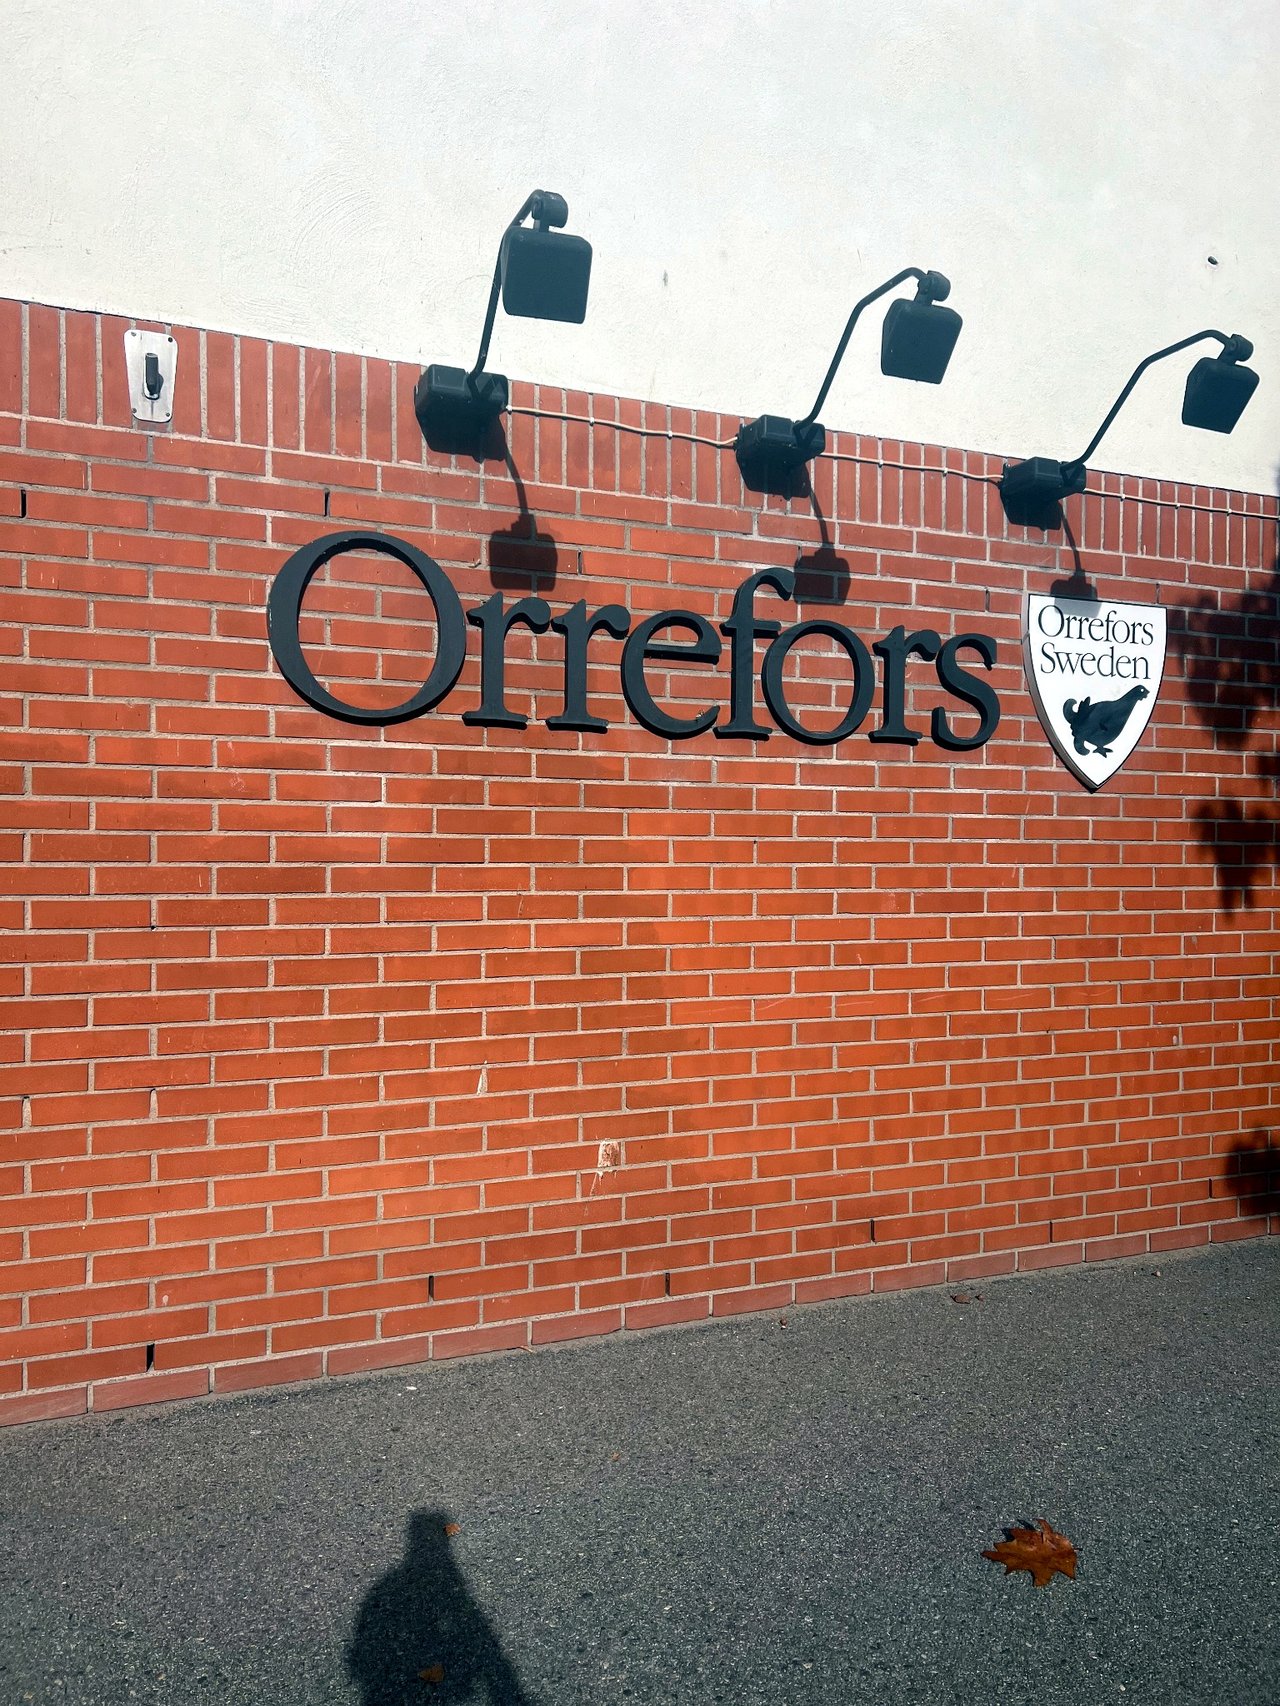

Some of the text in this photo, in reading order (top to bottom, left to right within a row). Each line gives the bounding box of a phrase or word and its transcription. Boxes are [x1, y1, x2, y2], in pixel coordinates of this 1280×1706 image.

[267, 530, 1001, 751] Orrefors
[1038, 604, 1154, 646] Orrefors
[1040, 641, 1151, 680] Sweden
